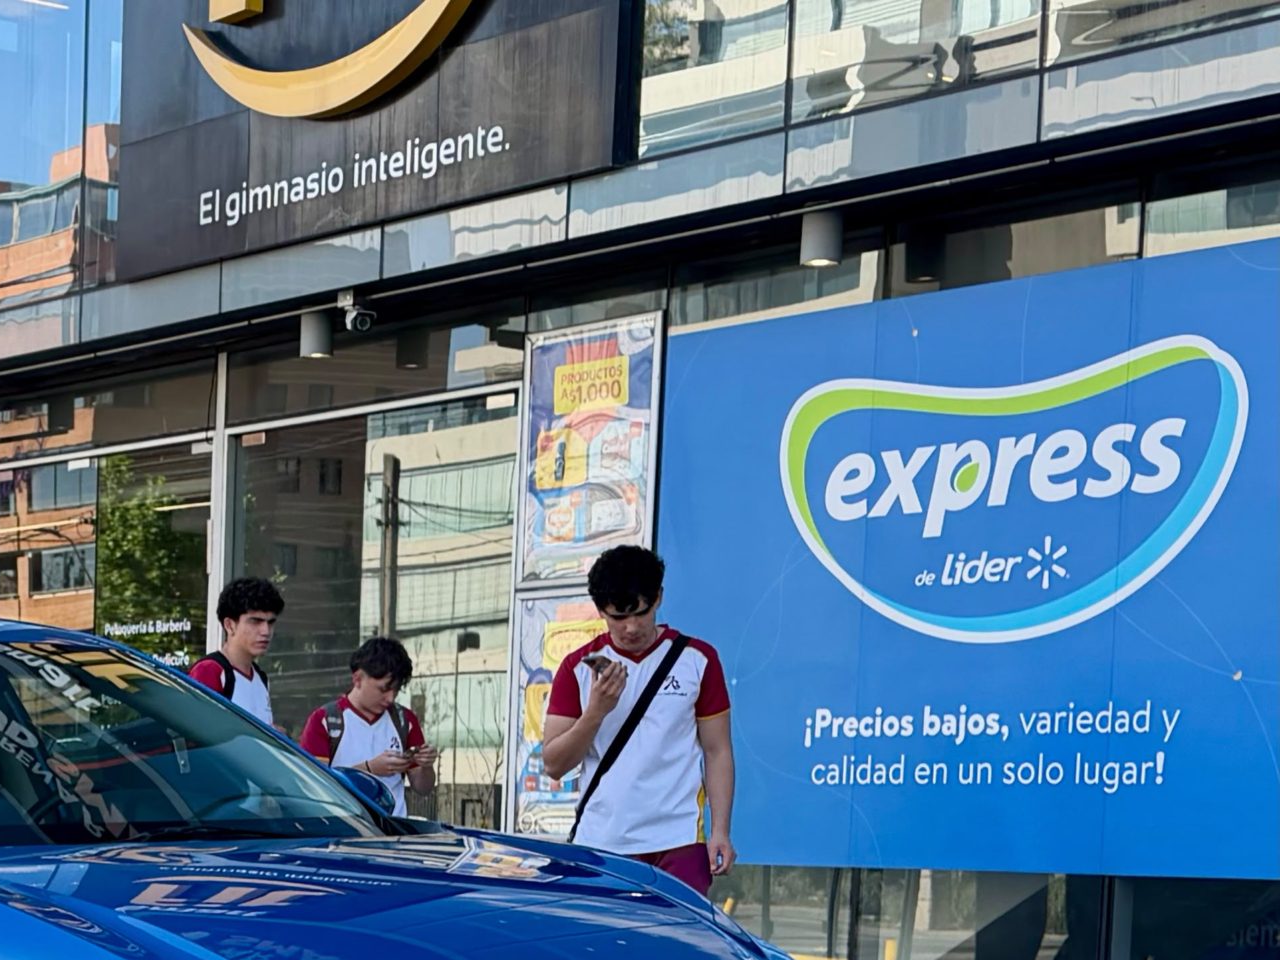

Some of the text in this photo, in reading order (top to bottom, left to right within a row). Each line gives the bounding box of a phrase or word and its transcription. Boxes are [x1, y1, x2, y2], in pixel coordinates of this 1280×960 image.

[199, 124, 511, 227] El gimnasio inteligente.
[560, 364, 623, 385] PRODUCTOS
[824, 417, 1186, 539] express
[914, 569, 936, 587] de
[104, 618, 191, 638] Peluquería & Barbería
[804, 700, 1181, 748] ¡Precios bajos, variedad y
[810, 750, 1165, 794] calidad en un solo lugar!
